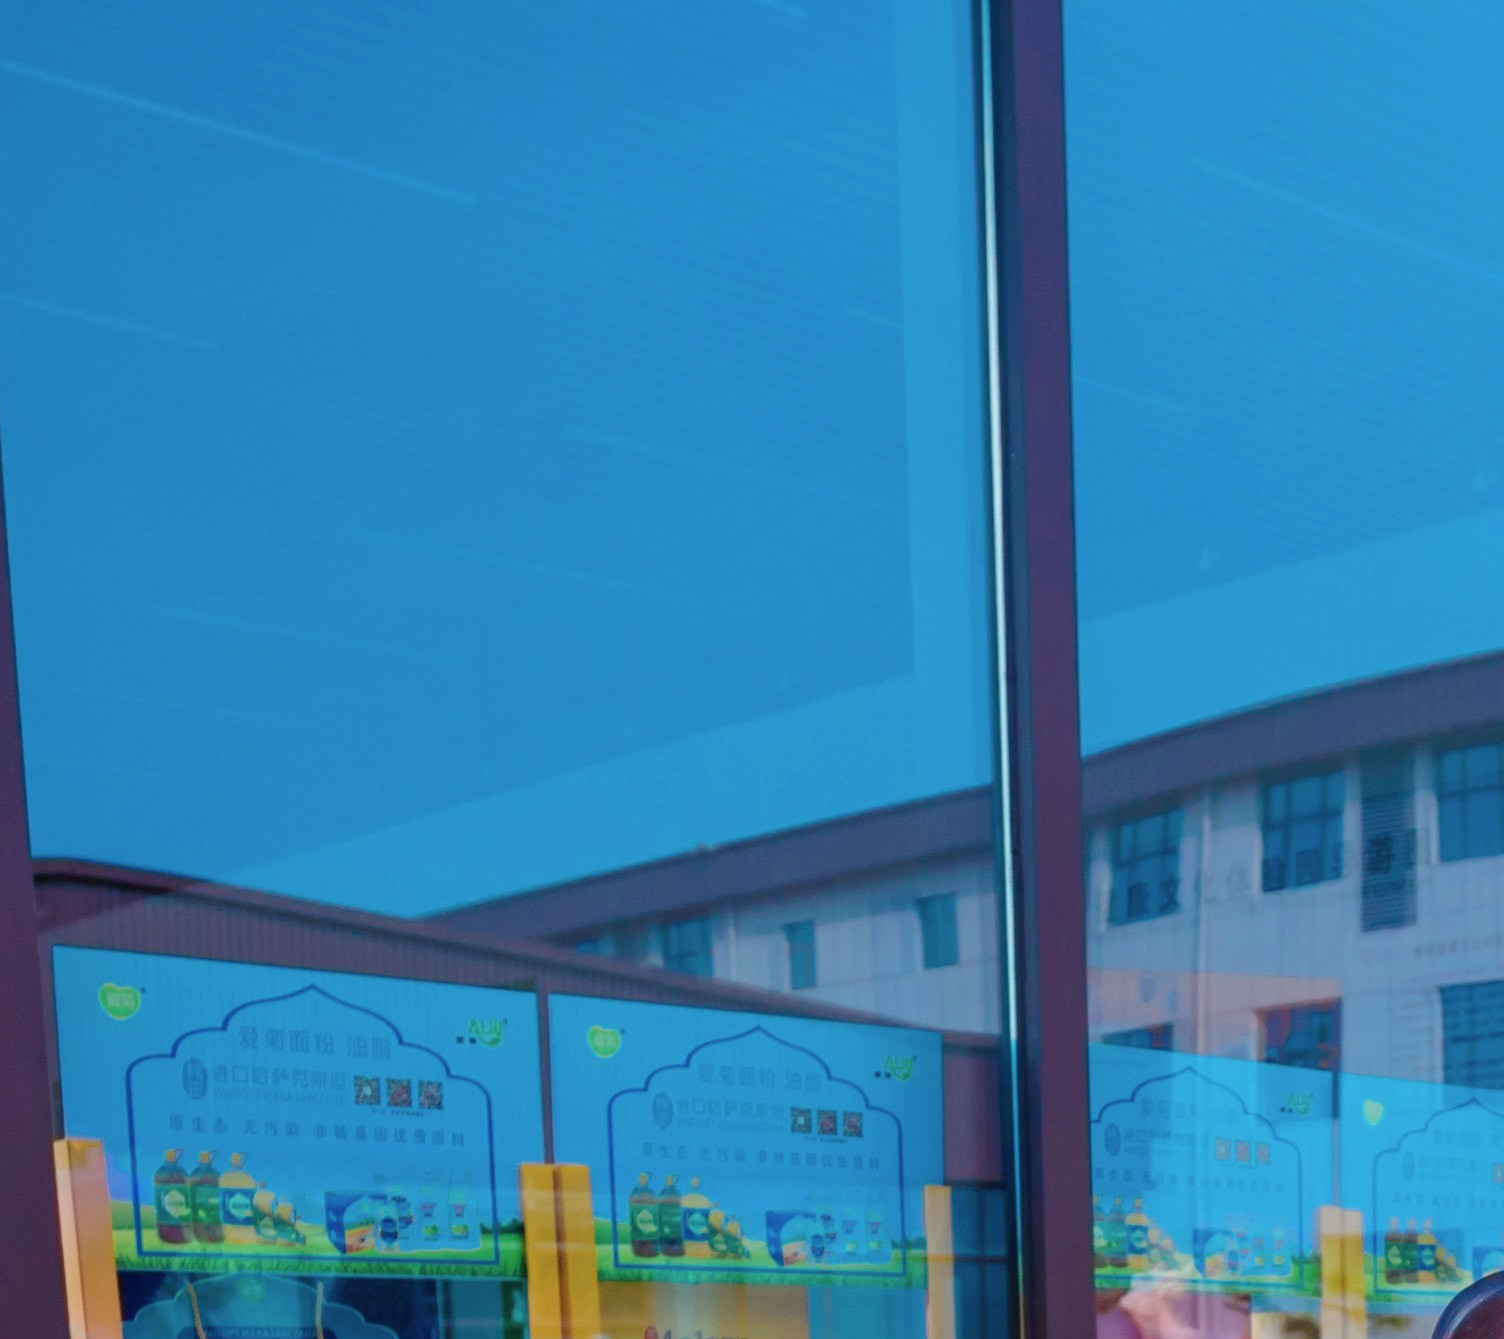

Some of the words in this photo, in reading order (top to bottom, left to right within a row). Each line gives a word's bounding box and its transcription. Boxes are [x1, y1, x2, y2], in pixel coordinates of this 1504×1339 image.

[239, 1025, 334, 1056] 爱菊面粉
[347, 1035, 392, 1060] 油脂
[213, 1063, 347, 1090] 进口哈萨克斯坦
[169, 1115, 228, 1134] 原生态
